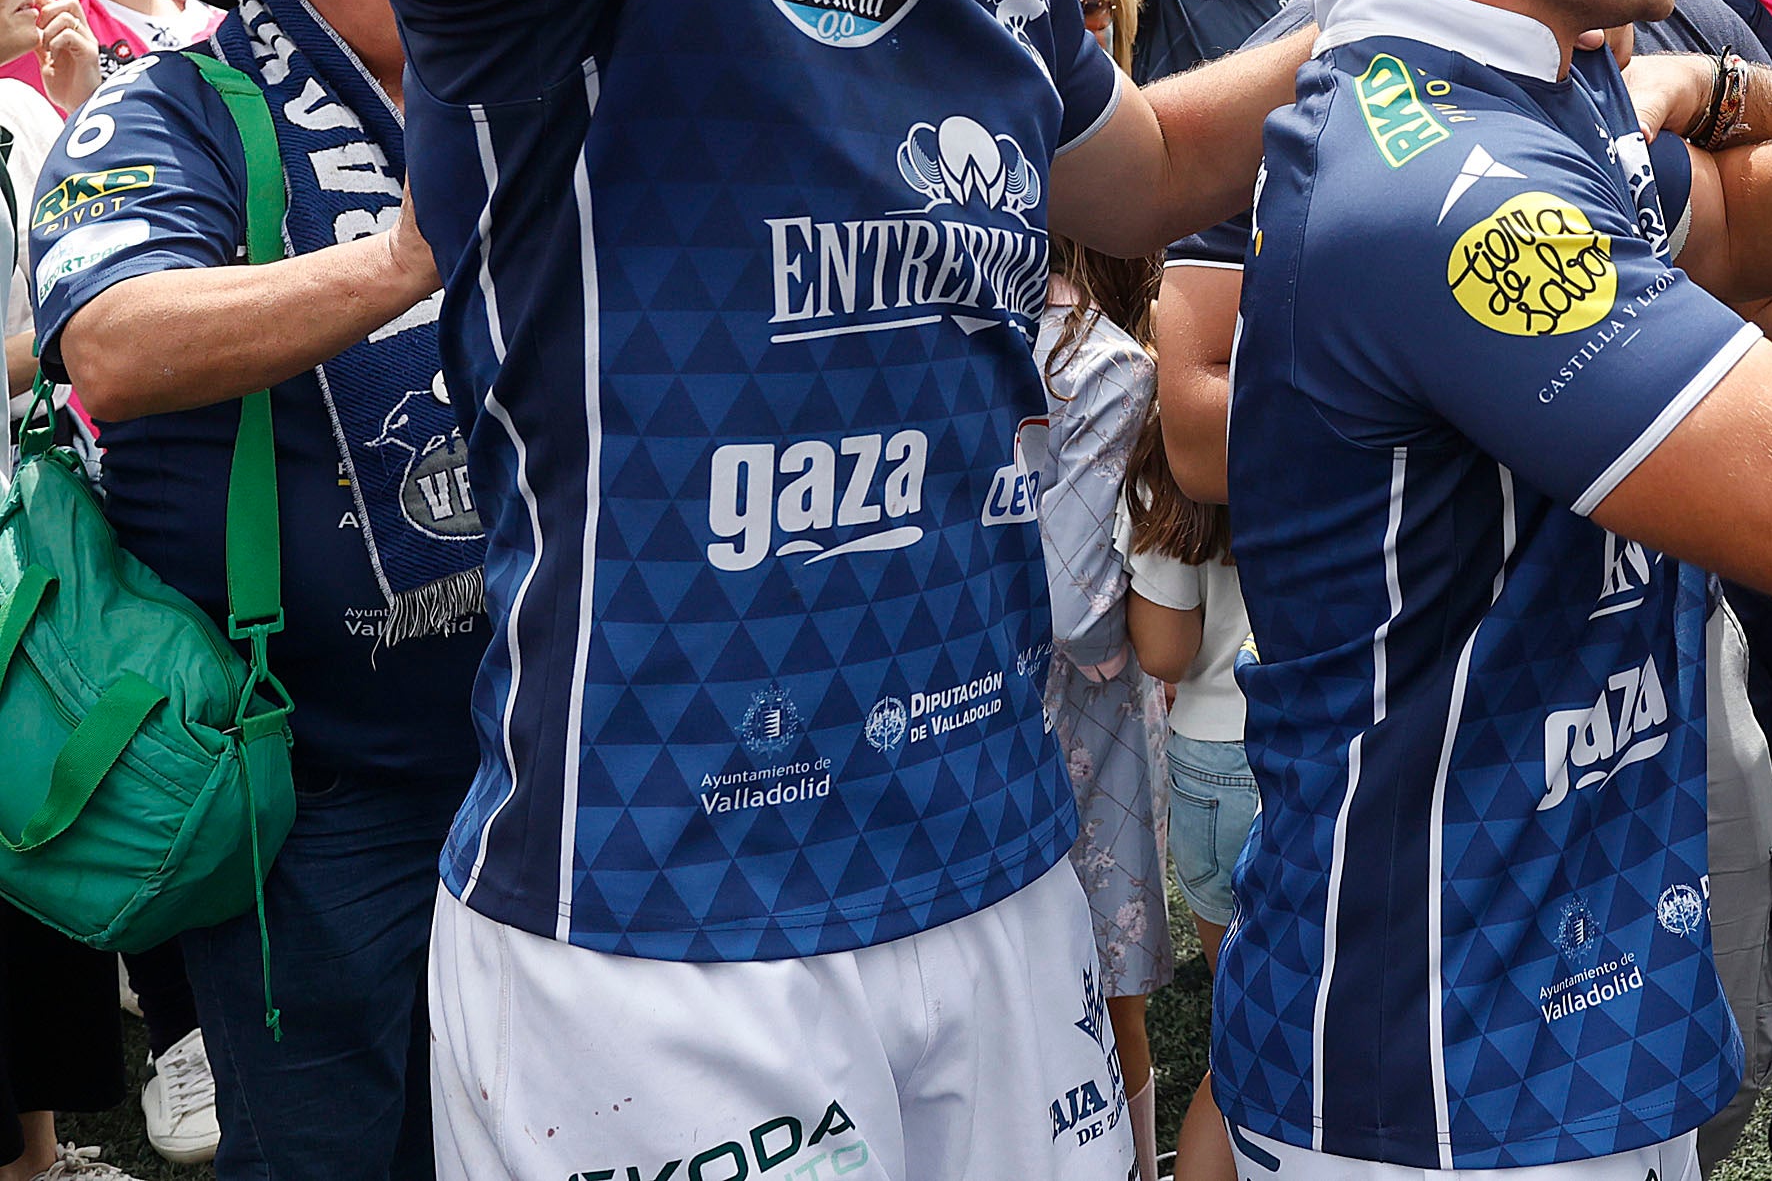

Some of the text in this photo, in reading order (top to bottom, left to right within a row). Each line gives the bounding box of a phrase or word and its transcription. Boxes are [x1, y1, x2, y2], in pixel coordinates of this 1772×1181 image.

[1361, 57, 1443, 158] RKD
[35, 169, 150, 223] RKD
[43, 197, 126, 236] PIVOT
[1489, 269, 1531, 316] de
[1538, 269, 1677, 404] CASTILLA Y LEÓN
[707, 430, 928, 571] gaza
[911, 671, 1003, 719] DIPUTACIÓN
[701, 756, 832, 788] Ayuntamiento de
[701, 774, 831, 816] Valladolid
[1539, 952, 1635, 1000] Ayuntamiento de
[1541, 966, 1644, 1024] Valladolid
[1076, 1120, 1104, 1147] DE
